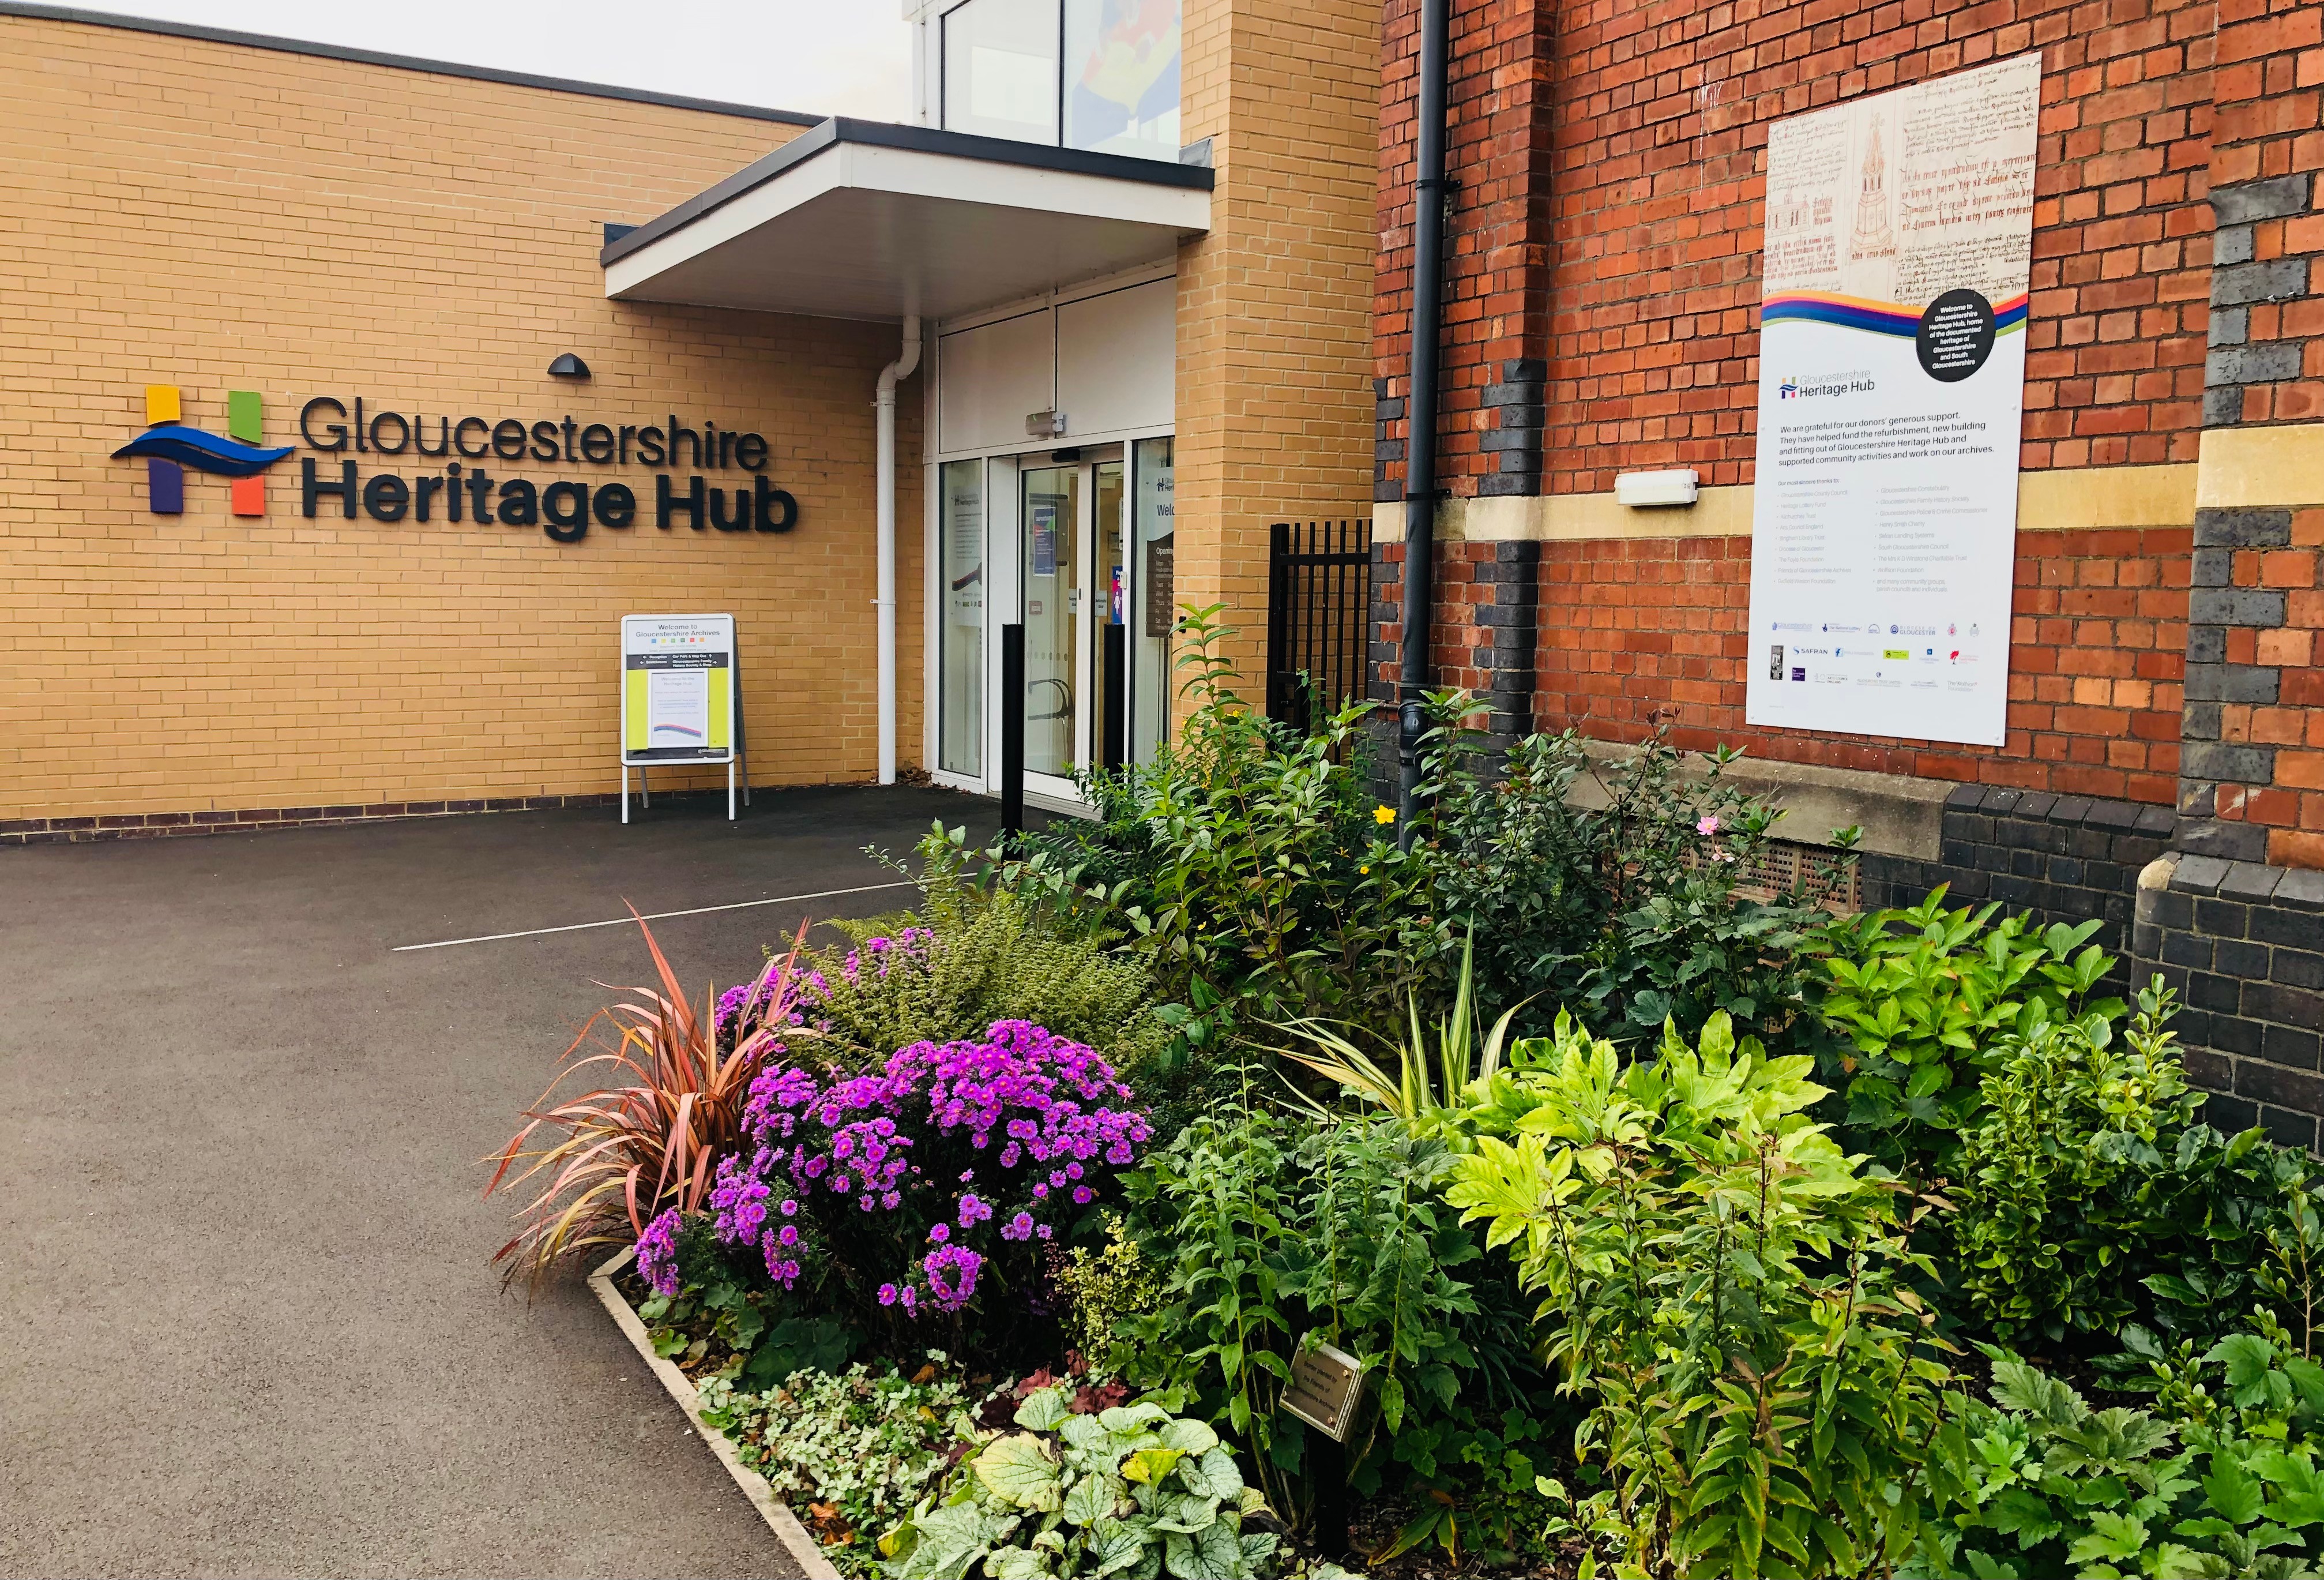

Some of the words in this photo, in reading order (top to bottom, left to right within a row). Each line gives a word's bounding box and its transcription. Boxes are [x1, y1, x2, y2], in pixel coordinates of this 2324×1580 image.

[1935, 311, 1978, 322] Gloucestershire
[1940, 305, 1966, 313] Welcome
[1946, 326, 1981, 336] documented
[1933, 344, 1976, 353] Gloucestershire
[1932, 359, 1976, 369] Gloucestershire
[1800, 369, 1870, 385] Gloucestershire
[1800, 384, 1848, 397] Heritage
[1851, 379, 1875, 392] Hub
[1804, 422, 1832, 433] grateful
[1889, 416, 1926, 426] generous
[1927, 412, 1961, 422] support.
[300, 396, 767, 471] Gloucestershire
[1780, 437, 1796, 445] They
[1816, 433, 1840, 442] helped
[1874, 426, 1930, 436] refurbishment,
[1932, 425, 1949, 433] new
[1951, 422, 1986, 431] building
[1793, 446, 1814, 455] fitting
[1837, 441, 1895, 451] Gloucestershire
[1897, 438, 1931, 446] Heritage
[1932, 436, 1949, 444] Hub
[1950, 434, 1966, 442] and
[1779, 457, 1814, 466] supported
[1816, 455, 1856, 463] community
[1909, 449, 1928, 457] work
[1958, 446, 1994, 454] archives.
[302, 457, 635, 542] Heritage
[656, 474, 797, 532] Hub
